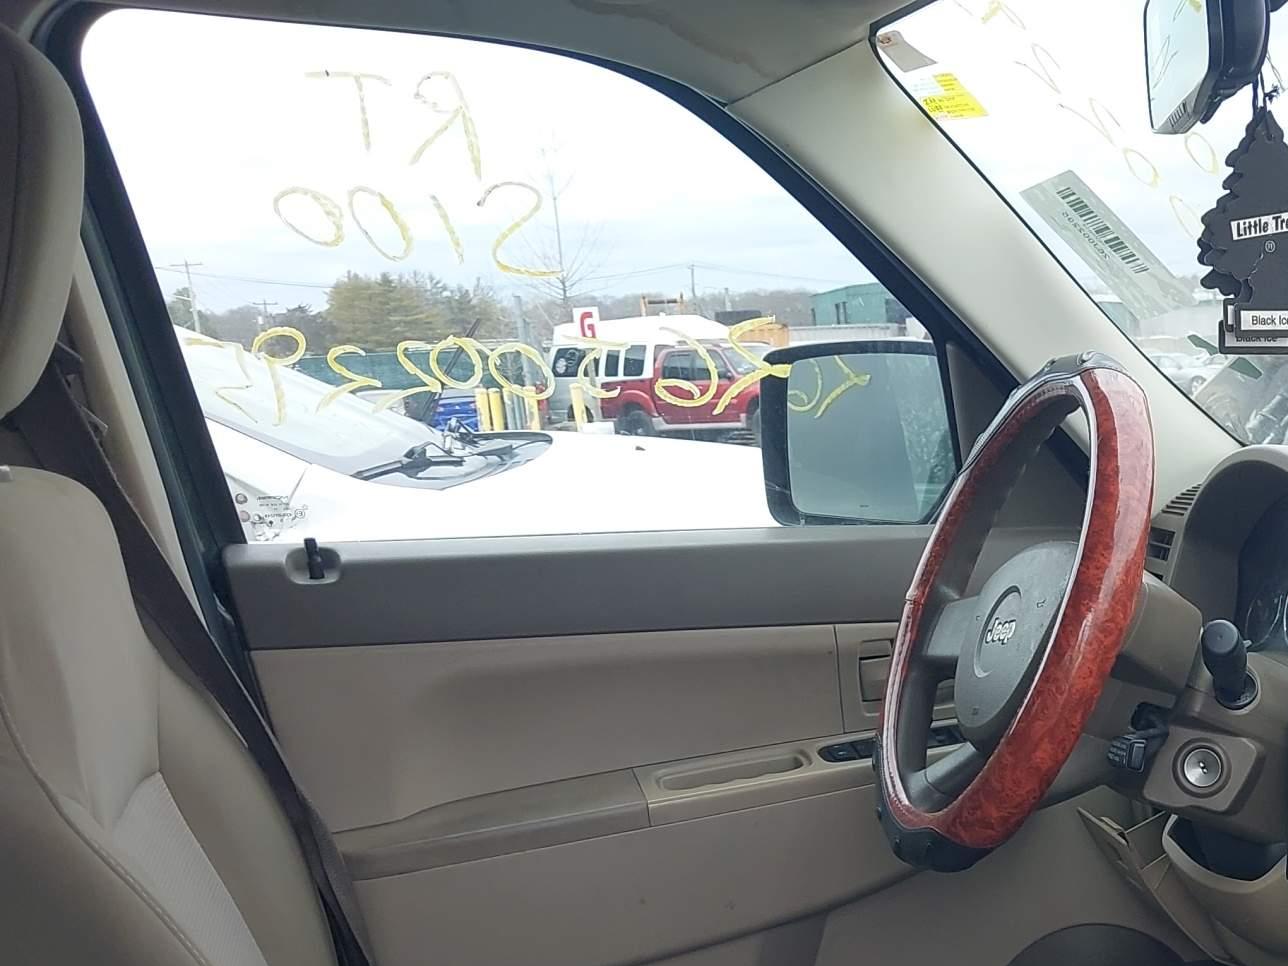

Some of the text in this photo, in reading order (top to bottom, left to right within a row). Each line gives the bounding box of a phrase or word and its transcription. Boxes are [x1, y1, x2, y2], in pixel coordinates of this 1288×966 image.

[1236, 219, 1269, 238] Little
[1251, 315, 1277, 326] Black
[985, 617, 1017, 645] Jeep
